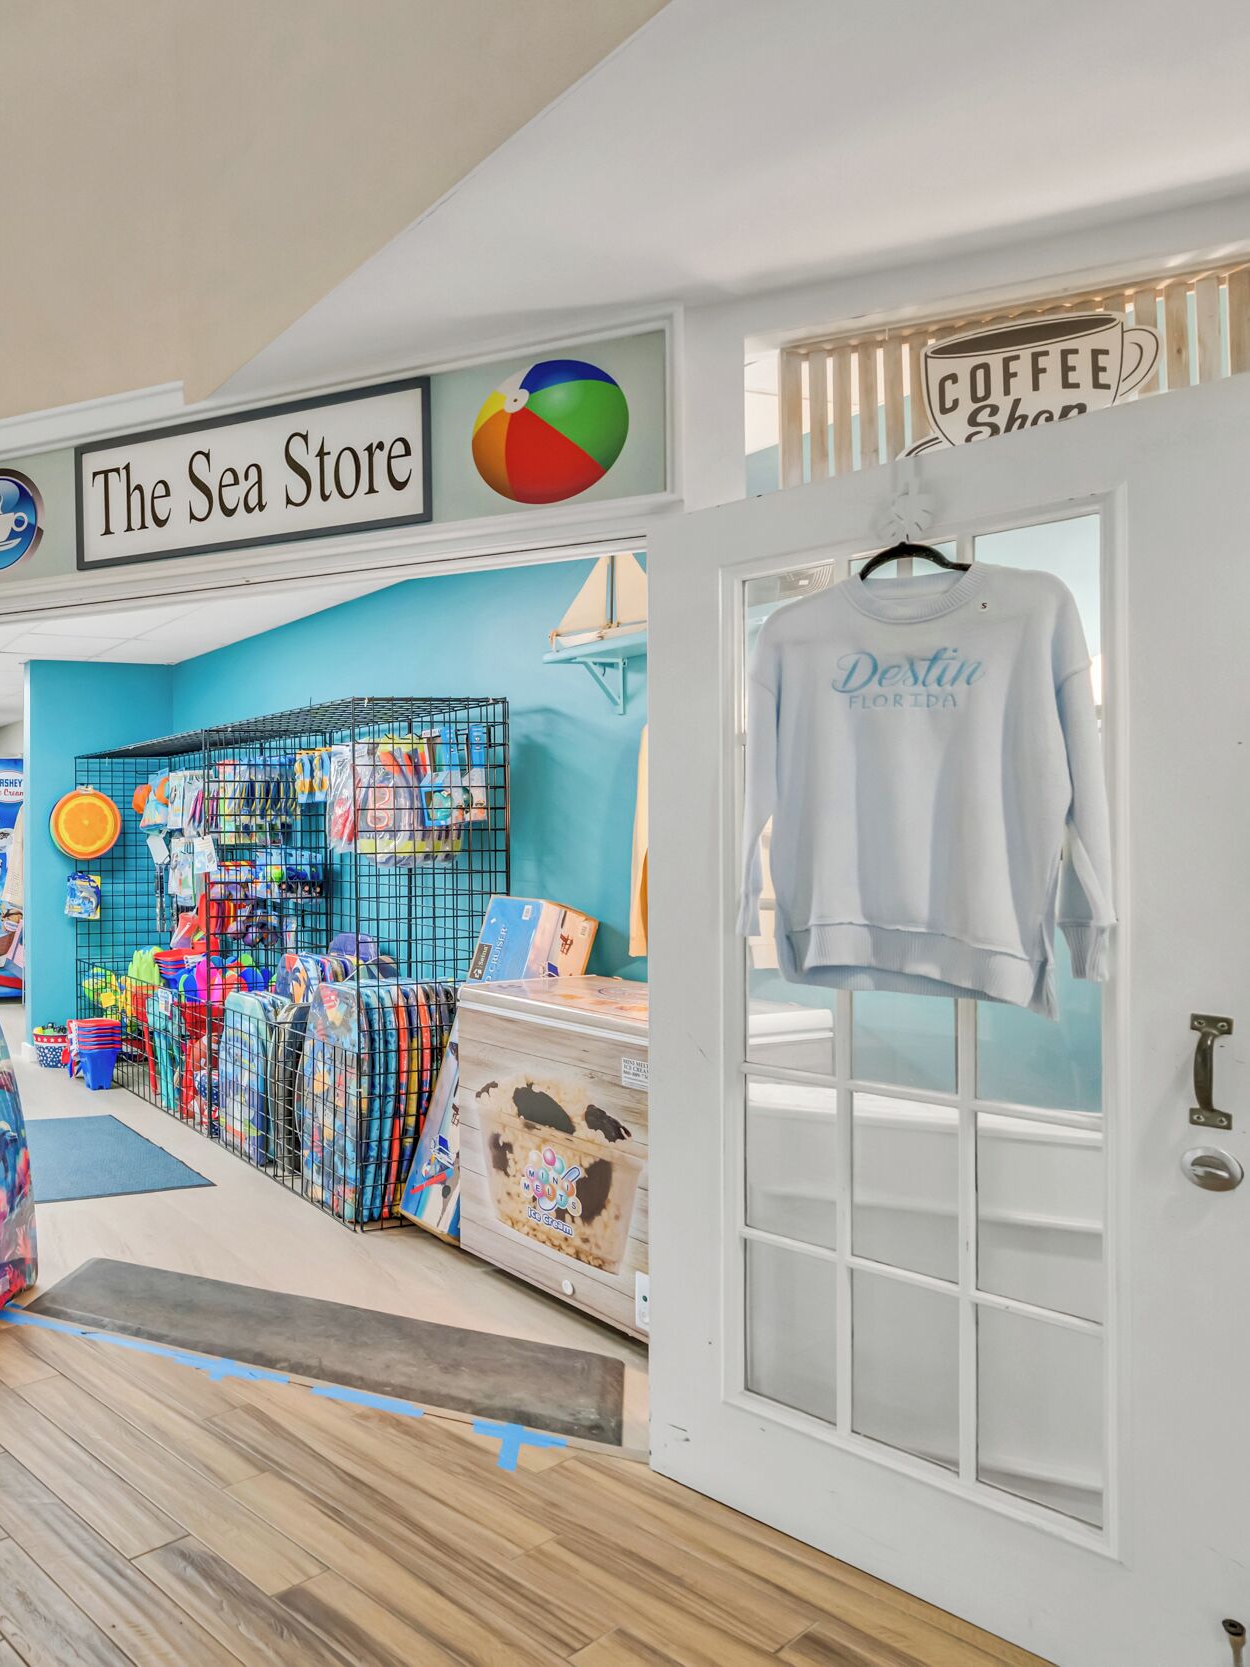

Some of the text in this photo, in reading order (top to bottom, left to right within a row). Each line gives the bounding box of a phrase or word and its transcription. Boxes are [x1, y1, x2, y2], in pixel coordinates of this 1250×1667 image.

[938, 348, 1111, 416] COFFEE
[92, 430, 413, 537] The Sea Store
[832, 647, 985, 694] Destin
[848, 693, 957, 709] FLORIDA
[490, 926, 508, 973] CRUISER
[527, 1207, 574, 1236] Ice Cream
